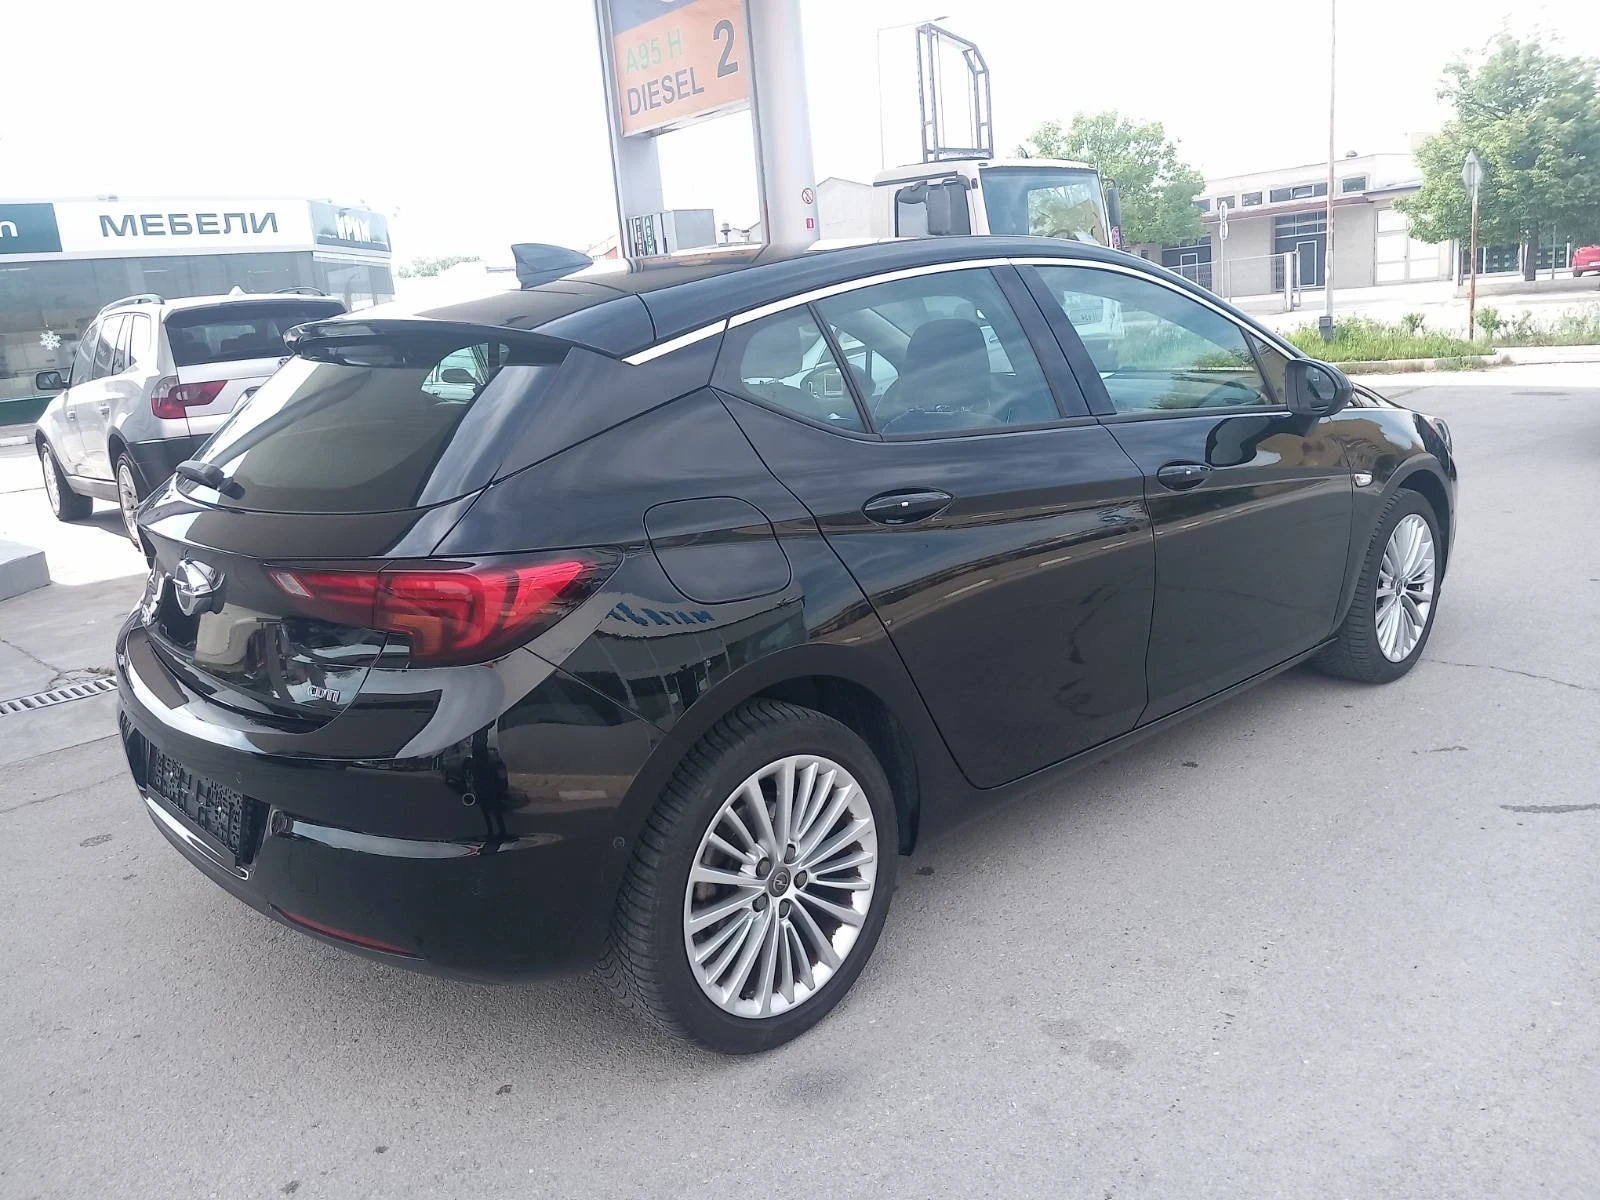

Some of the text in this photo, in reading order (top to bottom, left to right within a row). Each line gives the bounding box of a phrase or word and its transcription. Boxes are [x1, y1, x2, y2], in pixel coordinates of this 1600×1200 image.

[626, 27, 684, 74] A95 H
[713, 19, 739, 78] 2
[627, 66, 705, 116] DIESEL
[98, 212, 279, 238] МЕБЕЛИ
